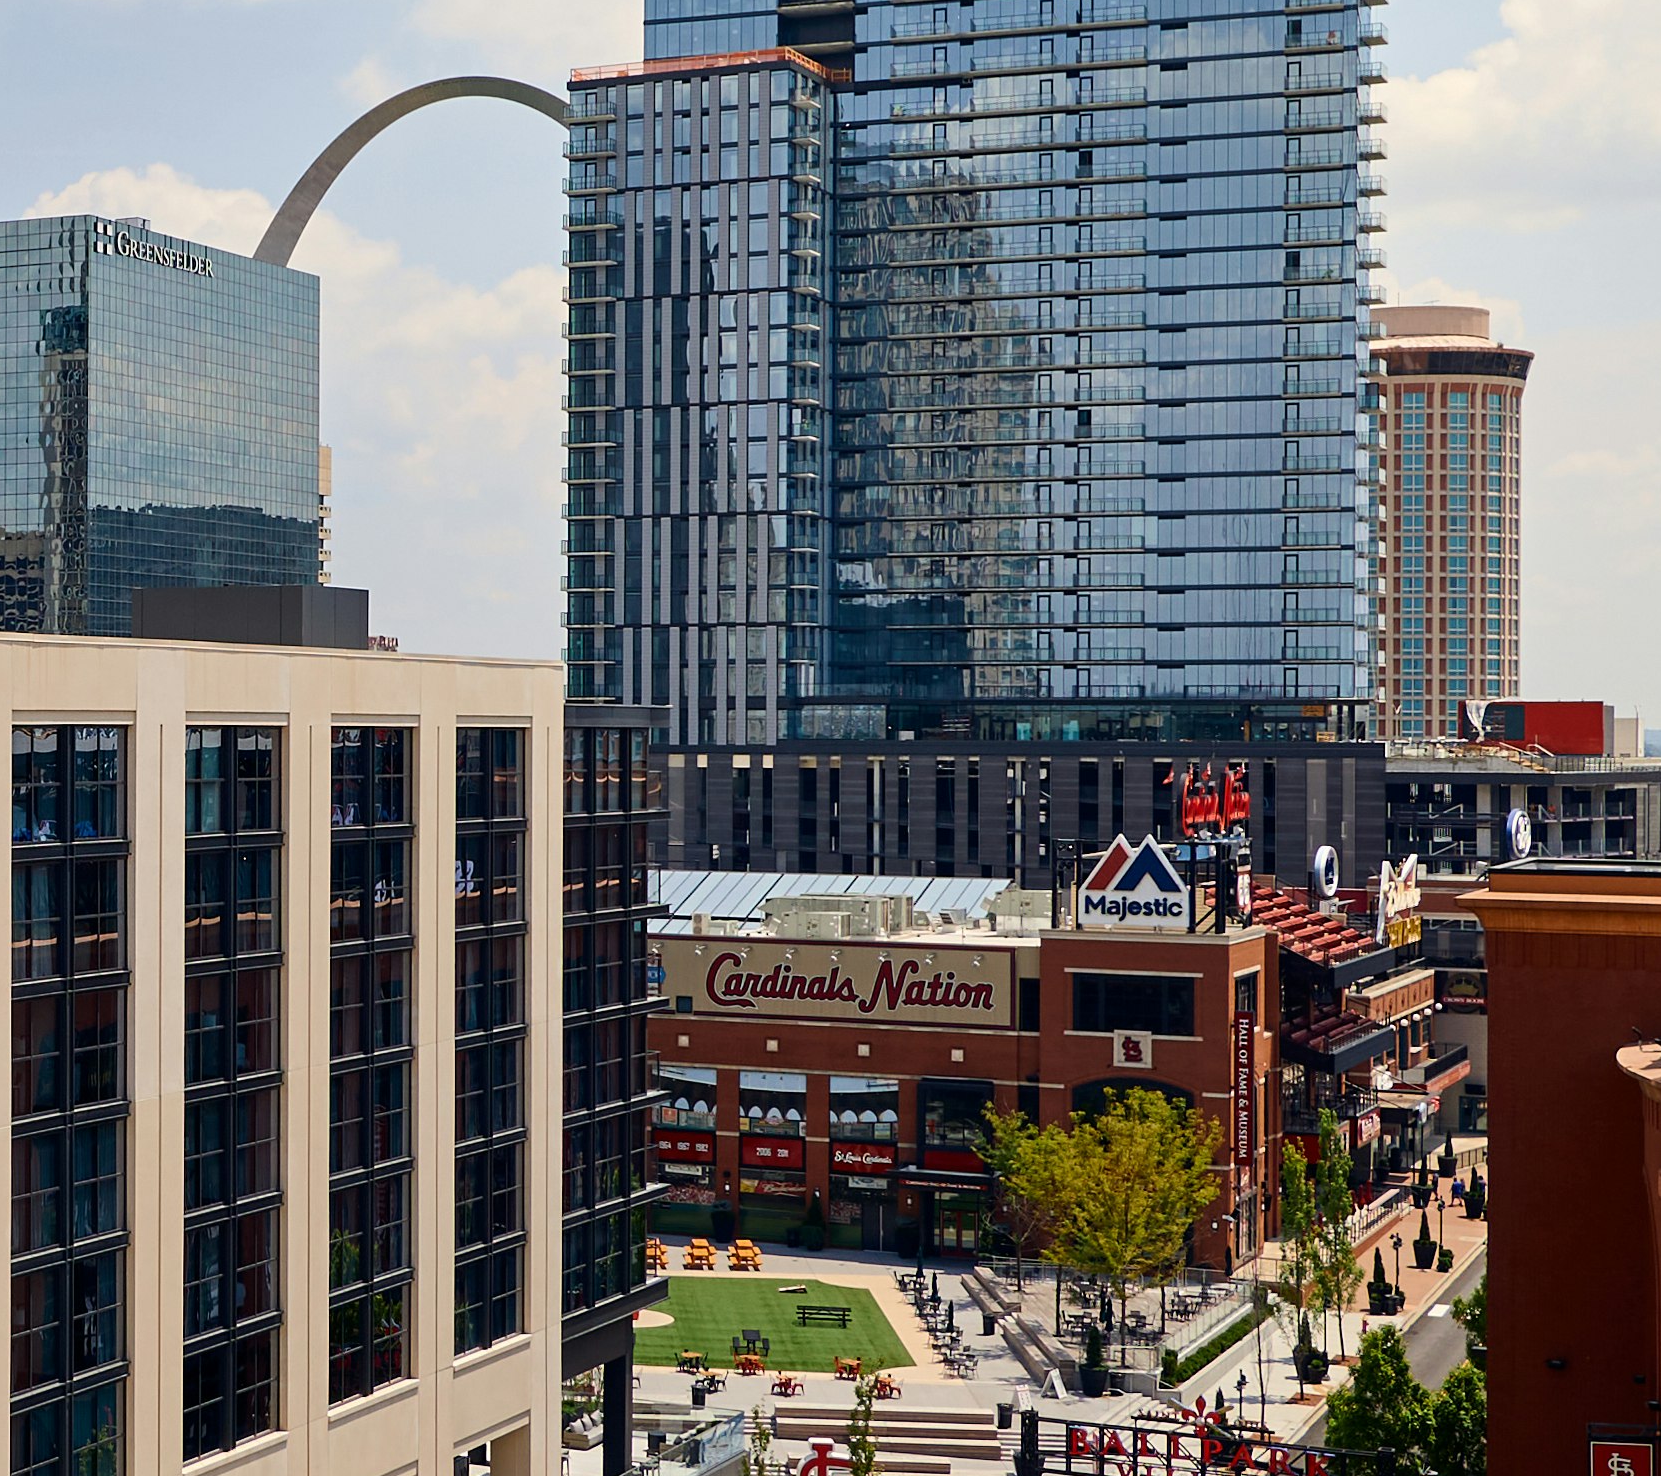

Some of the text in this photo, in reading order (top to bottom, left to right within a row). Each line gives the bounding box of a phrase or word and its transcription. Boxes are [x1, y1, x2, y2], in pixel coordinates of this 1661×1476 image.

[1084, 895, 1183, 922] Majestic
[705, 951, 995, 1014] Cardinals Nation
[1238, 1018, 1249, 1159] HALL OF FAME & MUSEUM
